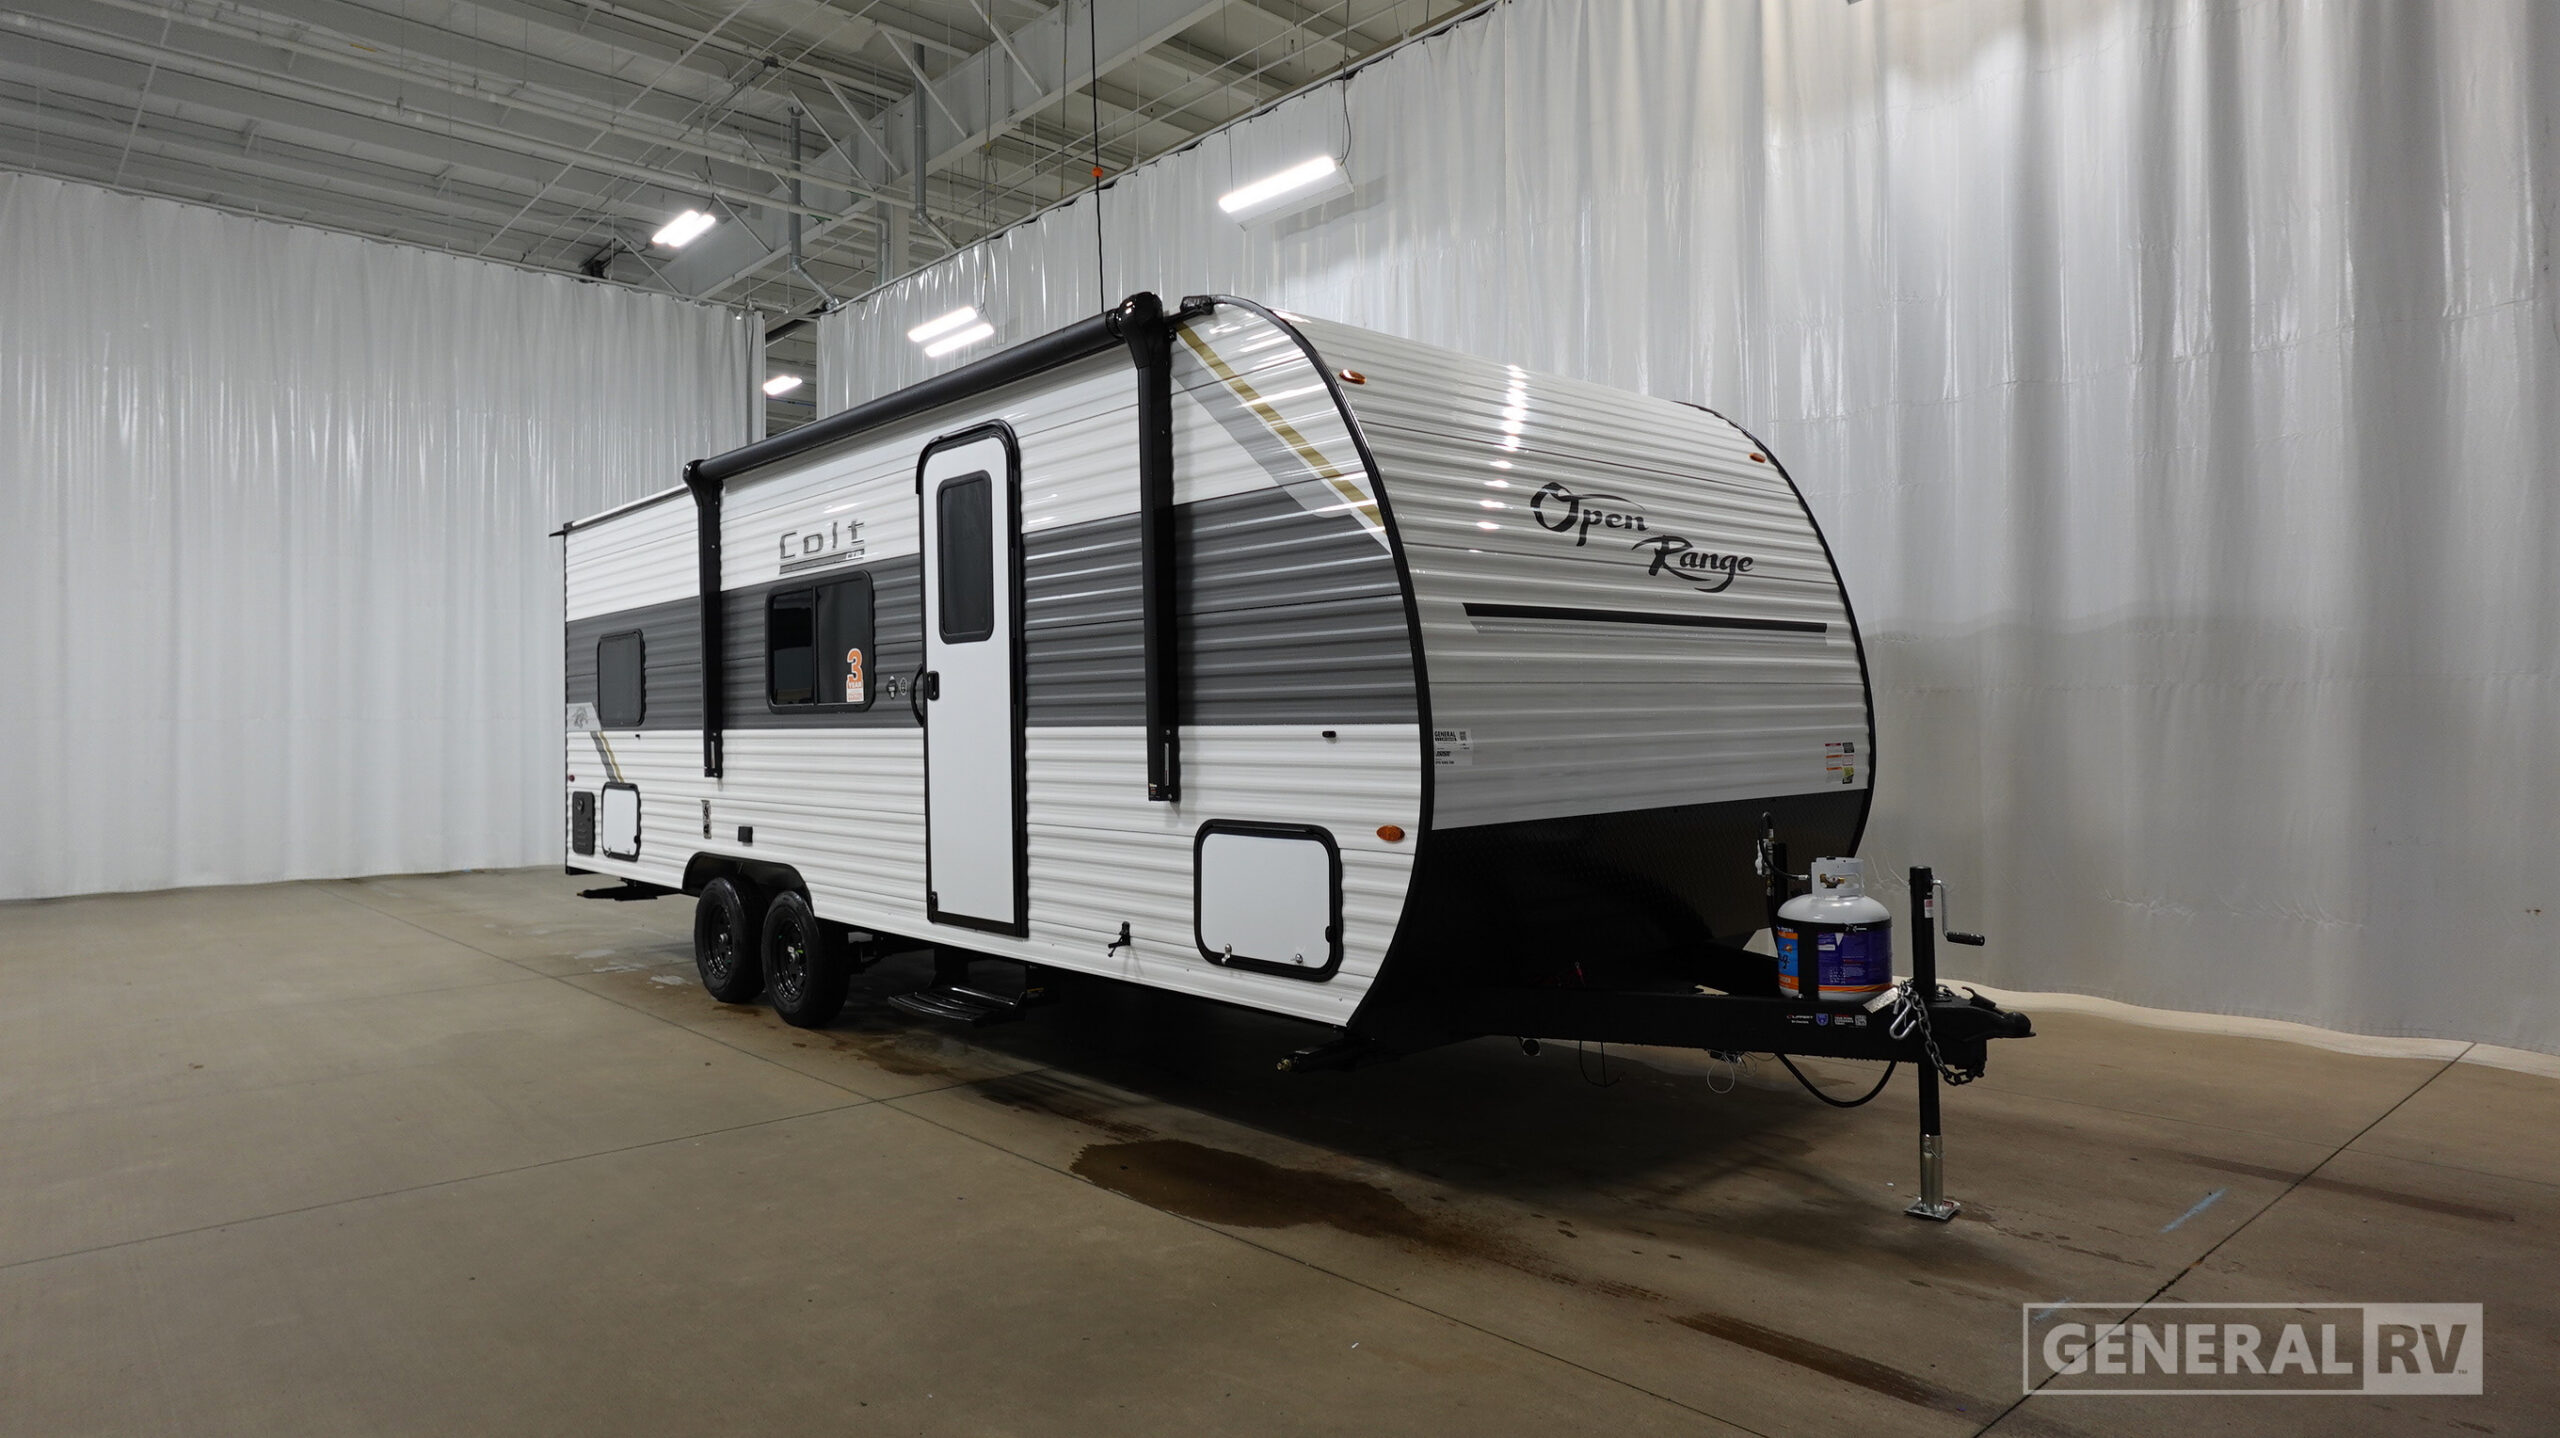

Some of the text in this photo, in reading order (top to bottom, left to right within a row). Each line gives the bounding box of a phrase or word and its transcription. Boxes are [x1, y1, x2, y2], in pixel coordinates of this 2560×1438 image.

[1530, 481, 1648, 547] Open
[780, 520, 865, 559] Colt
[1631, 535, 1753, 593] Range
[847, 648, 863, 682] 3
